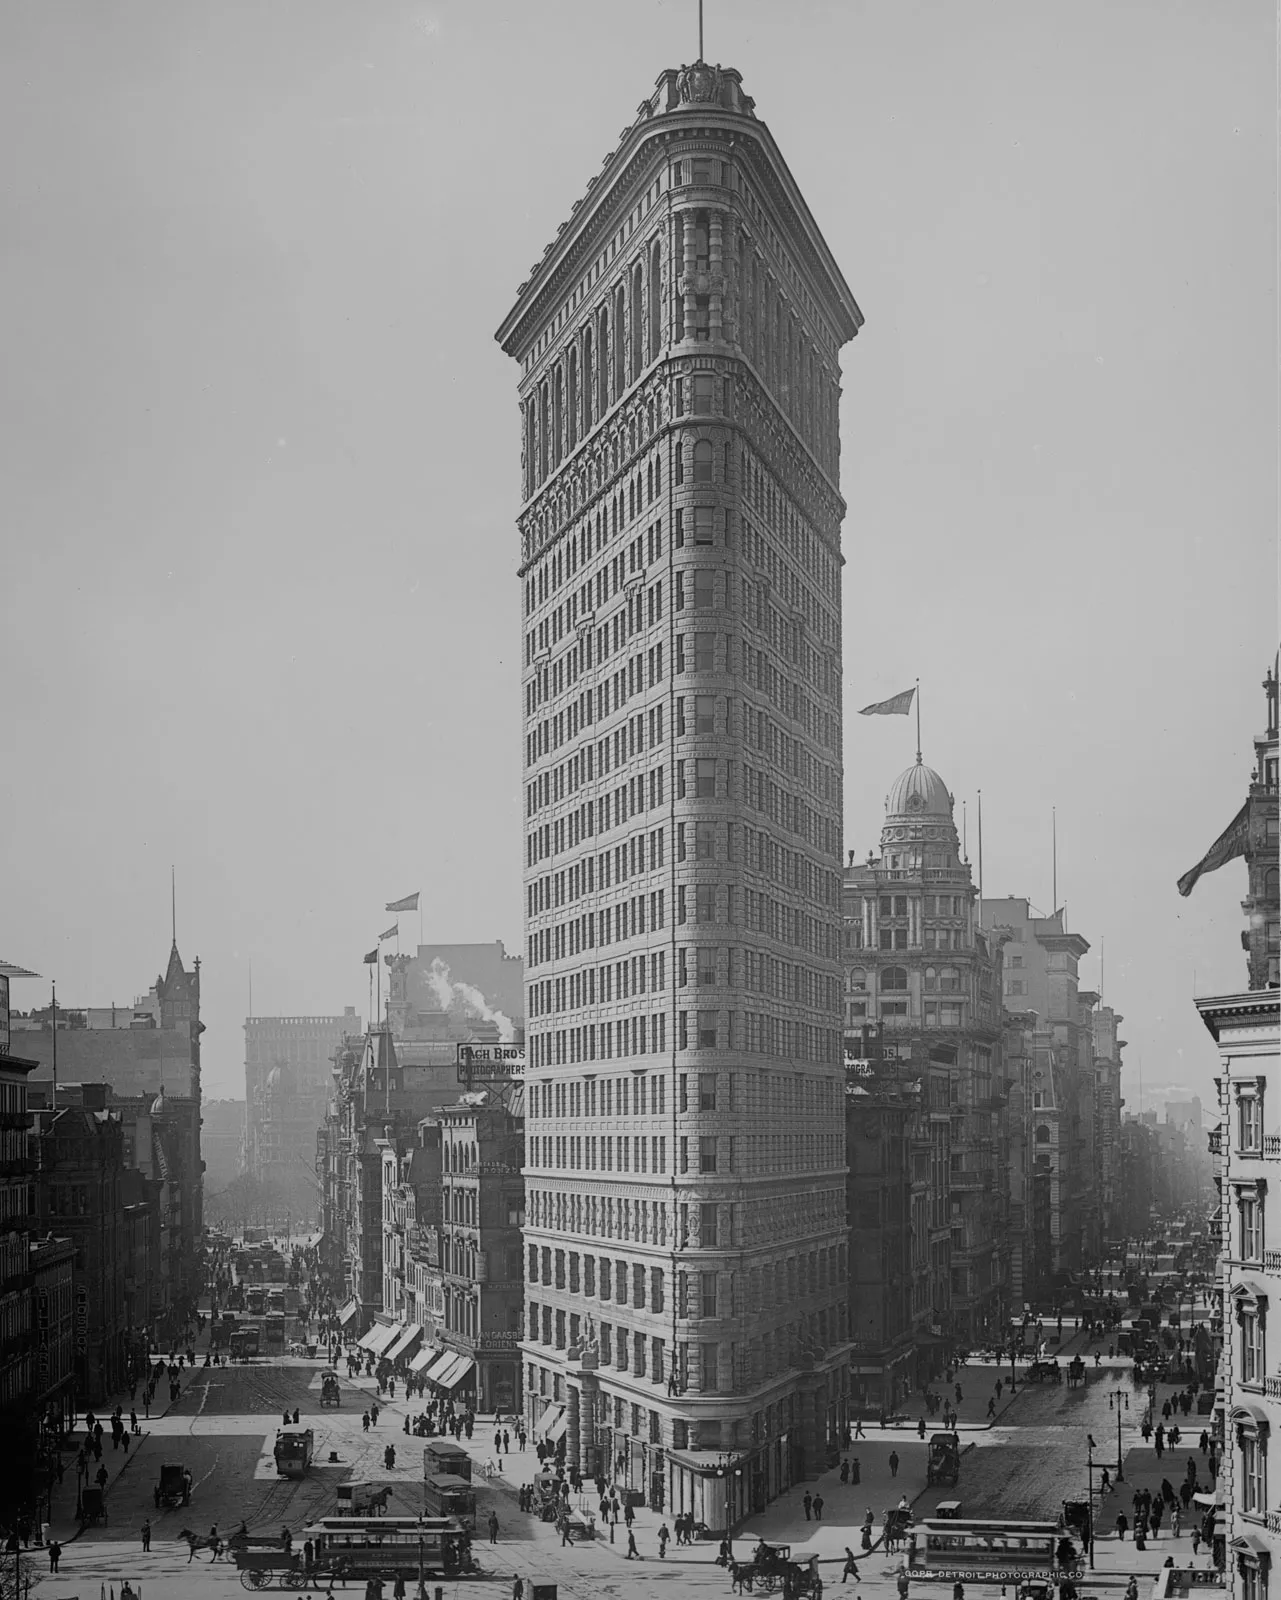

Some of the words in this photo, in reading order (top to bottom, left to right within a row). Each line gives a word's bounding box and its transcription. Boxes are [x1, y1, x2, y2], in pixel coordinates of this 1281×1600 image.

[494, 1047, 525, 1060] BROS
[38, 1287, 48, 1383] BILLIARDS
[77, 1285, 88, 1356] SLOSSON
